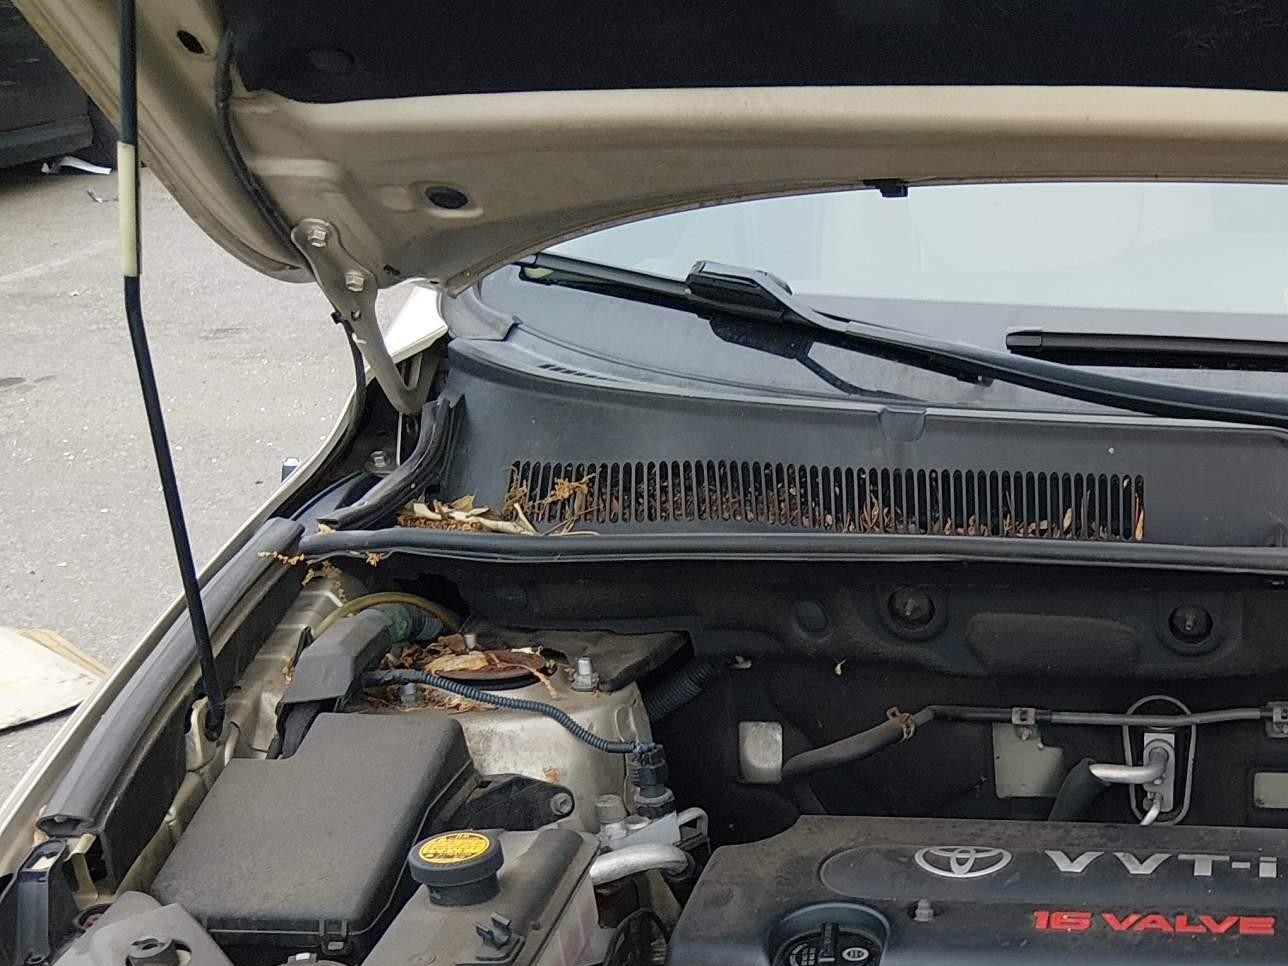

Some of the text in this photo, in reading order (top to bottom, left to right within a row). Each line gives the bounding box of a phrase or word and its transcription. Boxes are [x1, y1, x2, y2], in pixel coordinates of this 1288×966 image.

[1043, 849, 1278, 879] VVT-i
[1033, 910, 1276, 936] 16 VALVE
